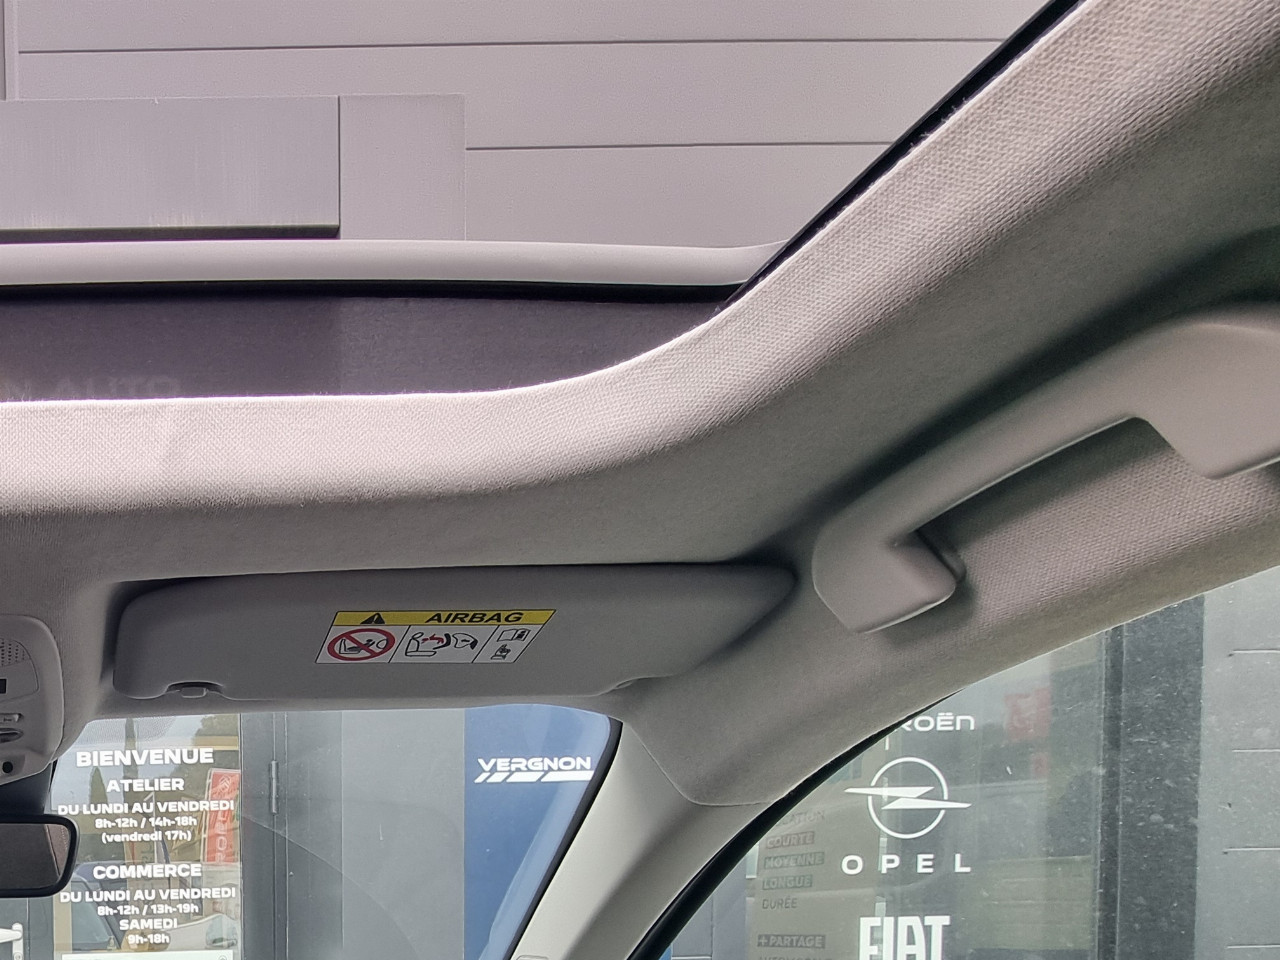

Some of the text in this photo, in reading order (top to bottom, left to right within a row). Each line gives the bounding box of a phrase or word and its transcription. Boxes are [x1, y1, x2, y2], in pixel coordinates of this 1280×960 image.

[425, 612, 524, 624] AIRBAG
[896, 712, 975, 732] ROËN
[76, 748, 214, 767] BIENVENUE
[477, 756, 591, 772] VERGNON
[106, 778, 184, 793] ATELIER
[58, 800, 234, 815] DU LUNDI AU VENDREDI
[95, 818, 137, 829] 8h-12h
[148, 816, 198, 828] 14h-18h
[102, 830, 191, 844] (vendredi 17h)
[766, 832, 814, 848] COURTE
[765, 853, 824, 869] MOYENNE
[841, 854, 972, 875] OPEL
[93, 864, 202, 879] COMMERCE
[763, 875, 812, 890] LONGUE
[60, 887, 236, 903] DU LUNDI AU VENDREDI
[97, 905, 139, 916] 8h-12h
[150, 903, 199, 914] 13h-19h
[762, 896, 798, 910] DURÉE
[119, 918, 178, 930] SAMEDI
[127, 933, 170, 945] 9h-18h
